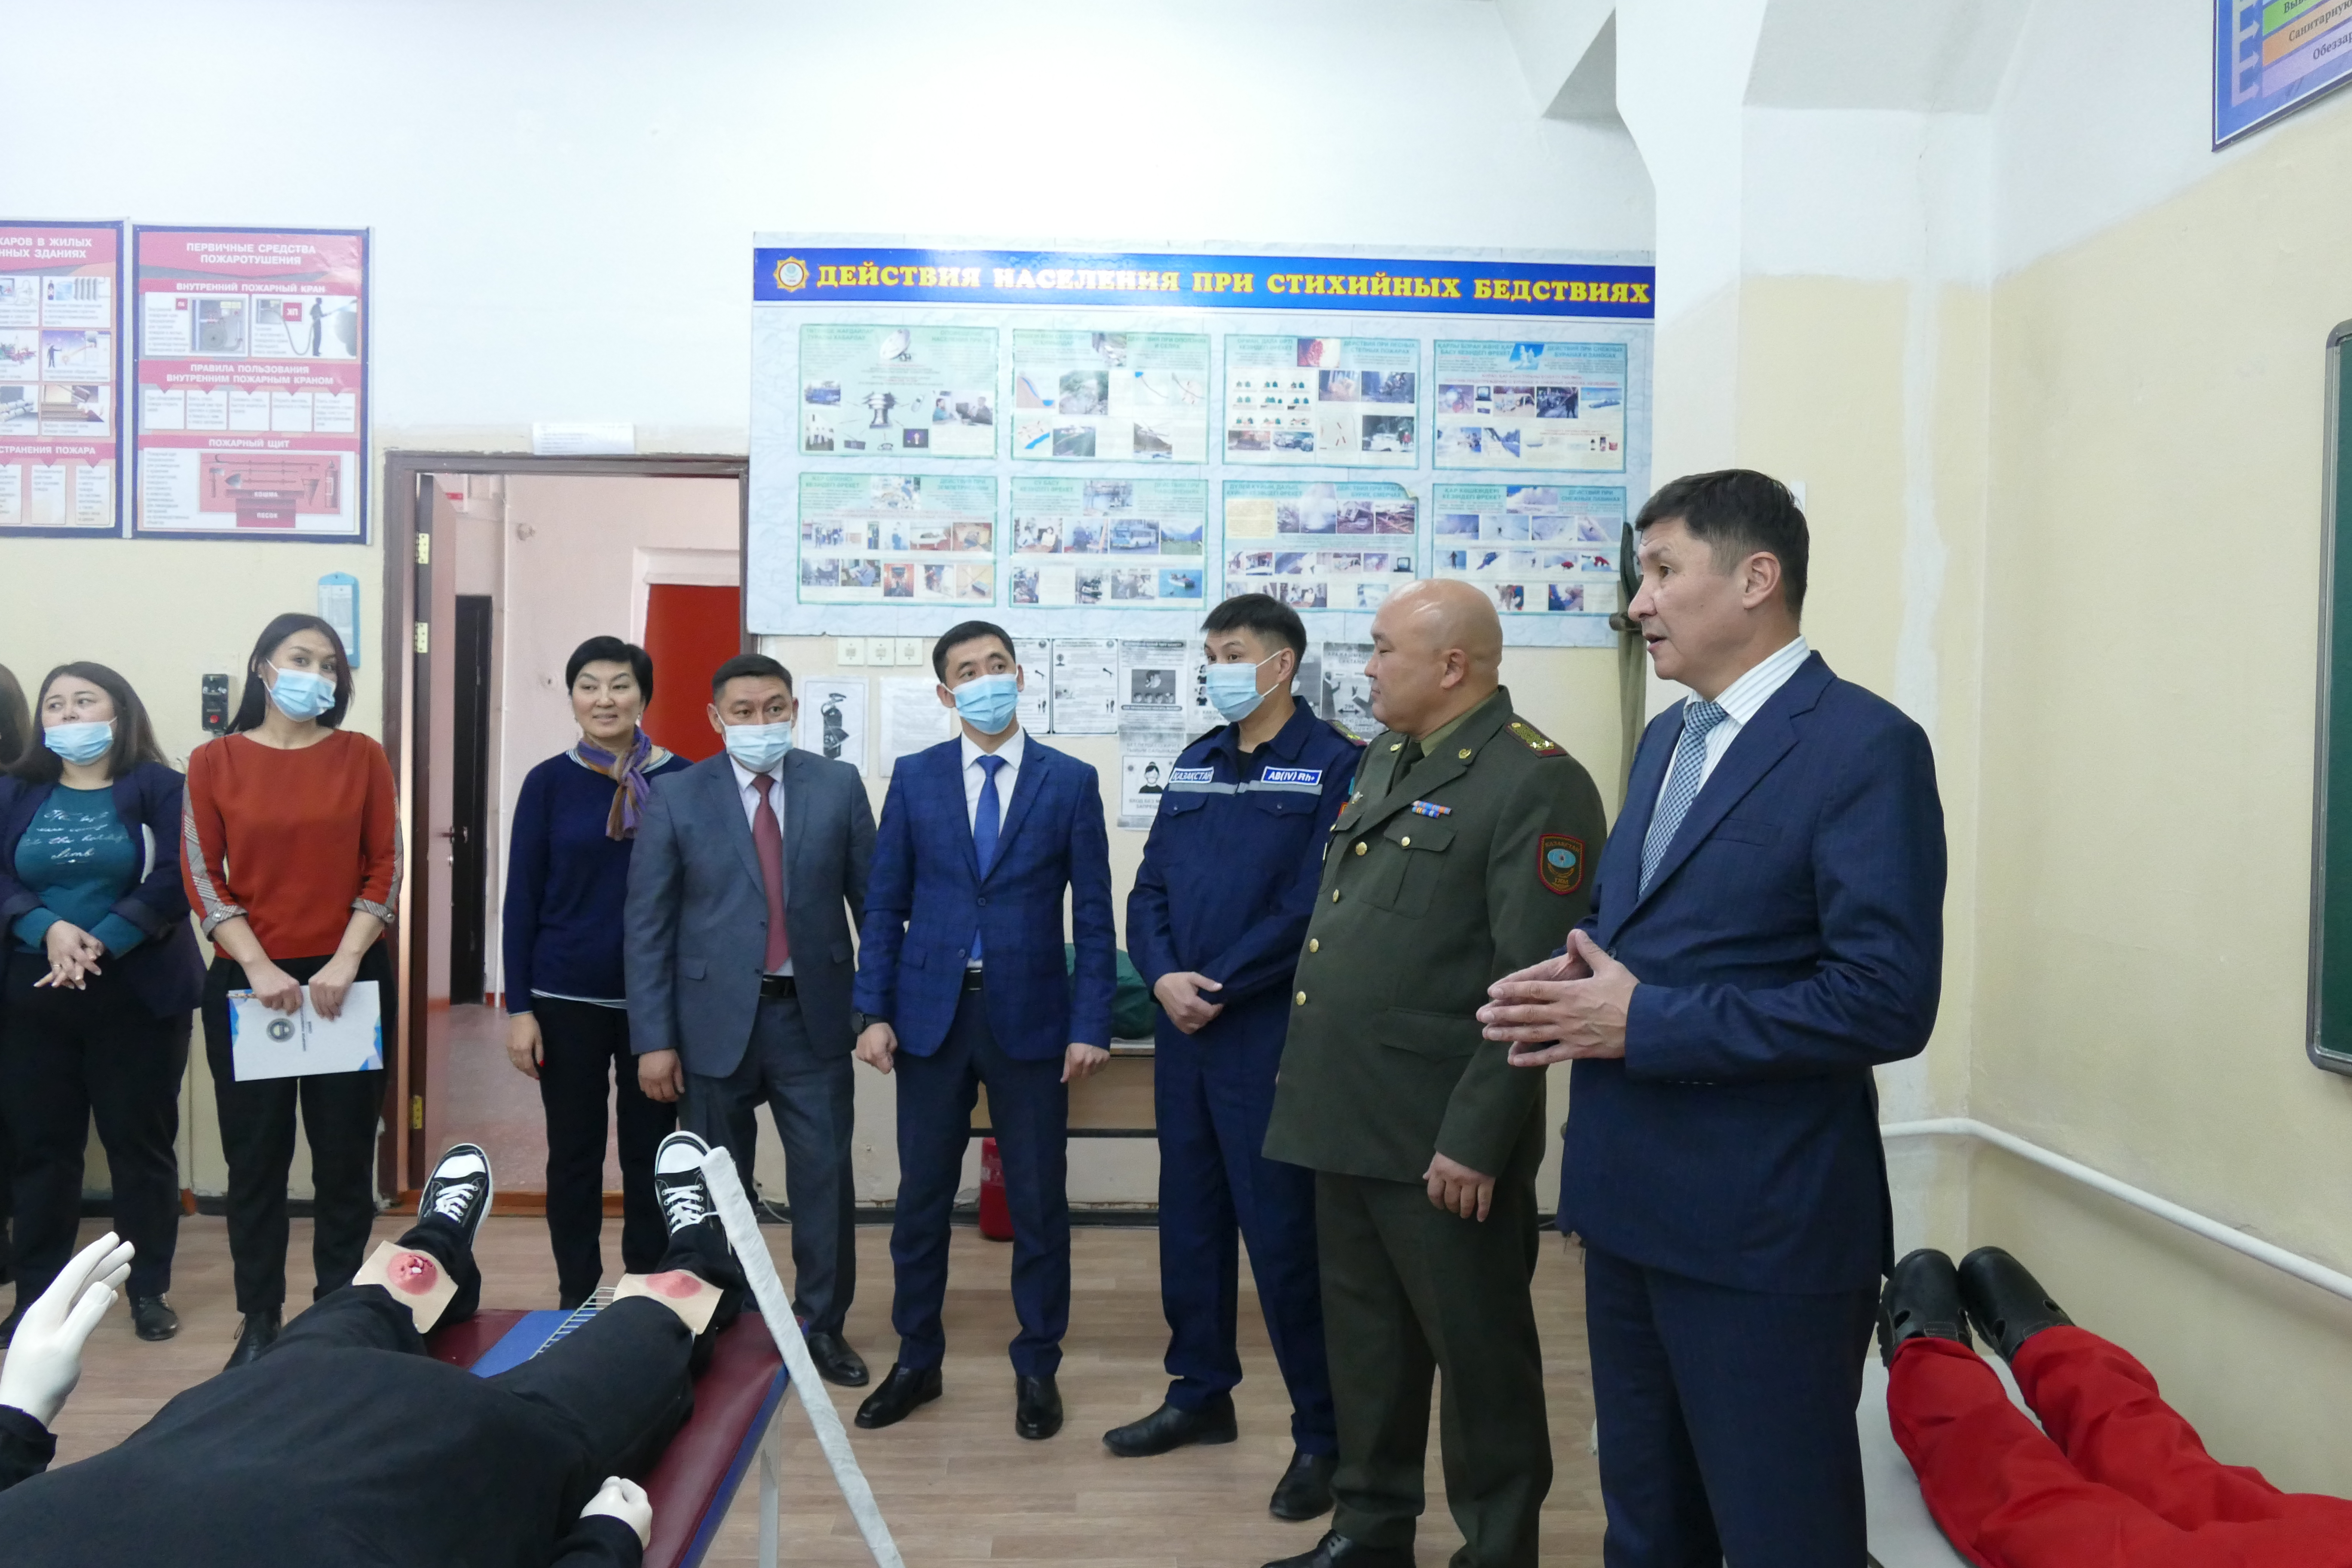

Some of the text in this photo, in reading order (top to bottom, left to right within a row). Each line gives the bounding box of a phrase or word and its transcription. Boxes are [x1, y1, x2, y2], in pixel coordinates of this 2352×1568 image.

[2288, 0, 2352, 42] Санитарную
[37, 238, 45, 246] В
[49, 238, 92, 247] ЖИЛЫХ
[34, 249, 86, 259] ЗДАНИЯХ
[187, 243, 316, 254] ПЕРВИЧНЫЕ СРЕДСТВА
[200, 254, 302, 265] ПОЖАРОТУШЕНИЯ
[816, 260, 1651, 303] ДЕЙСТВИЯ НАСЕЛЕНИЯ ПРИ СТИХИЙНЫХ БЕДСТВИЯХ
[176, 282, 238, 292] ВНУТРЕННИЙ
[242, 283, 297, 293] ПОЖАРНЫЙ
[190, 364, 309, 374] ПРАВИЛА ПОЛЬЗОВАНИЯ
[166, 374, 334, 385] ВНУТРЕННИМ ПОЖАРНЫМ КРАНОМ
[209, 438, 290, 448] ПОЖАРНЫЙ ЩИТ
[56, 446, 96, 455] ПОЖАРА
